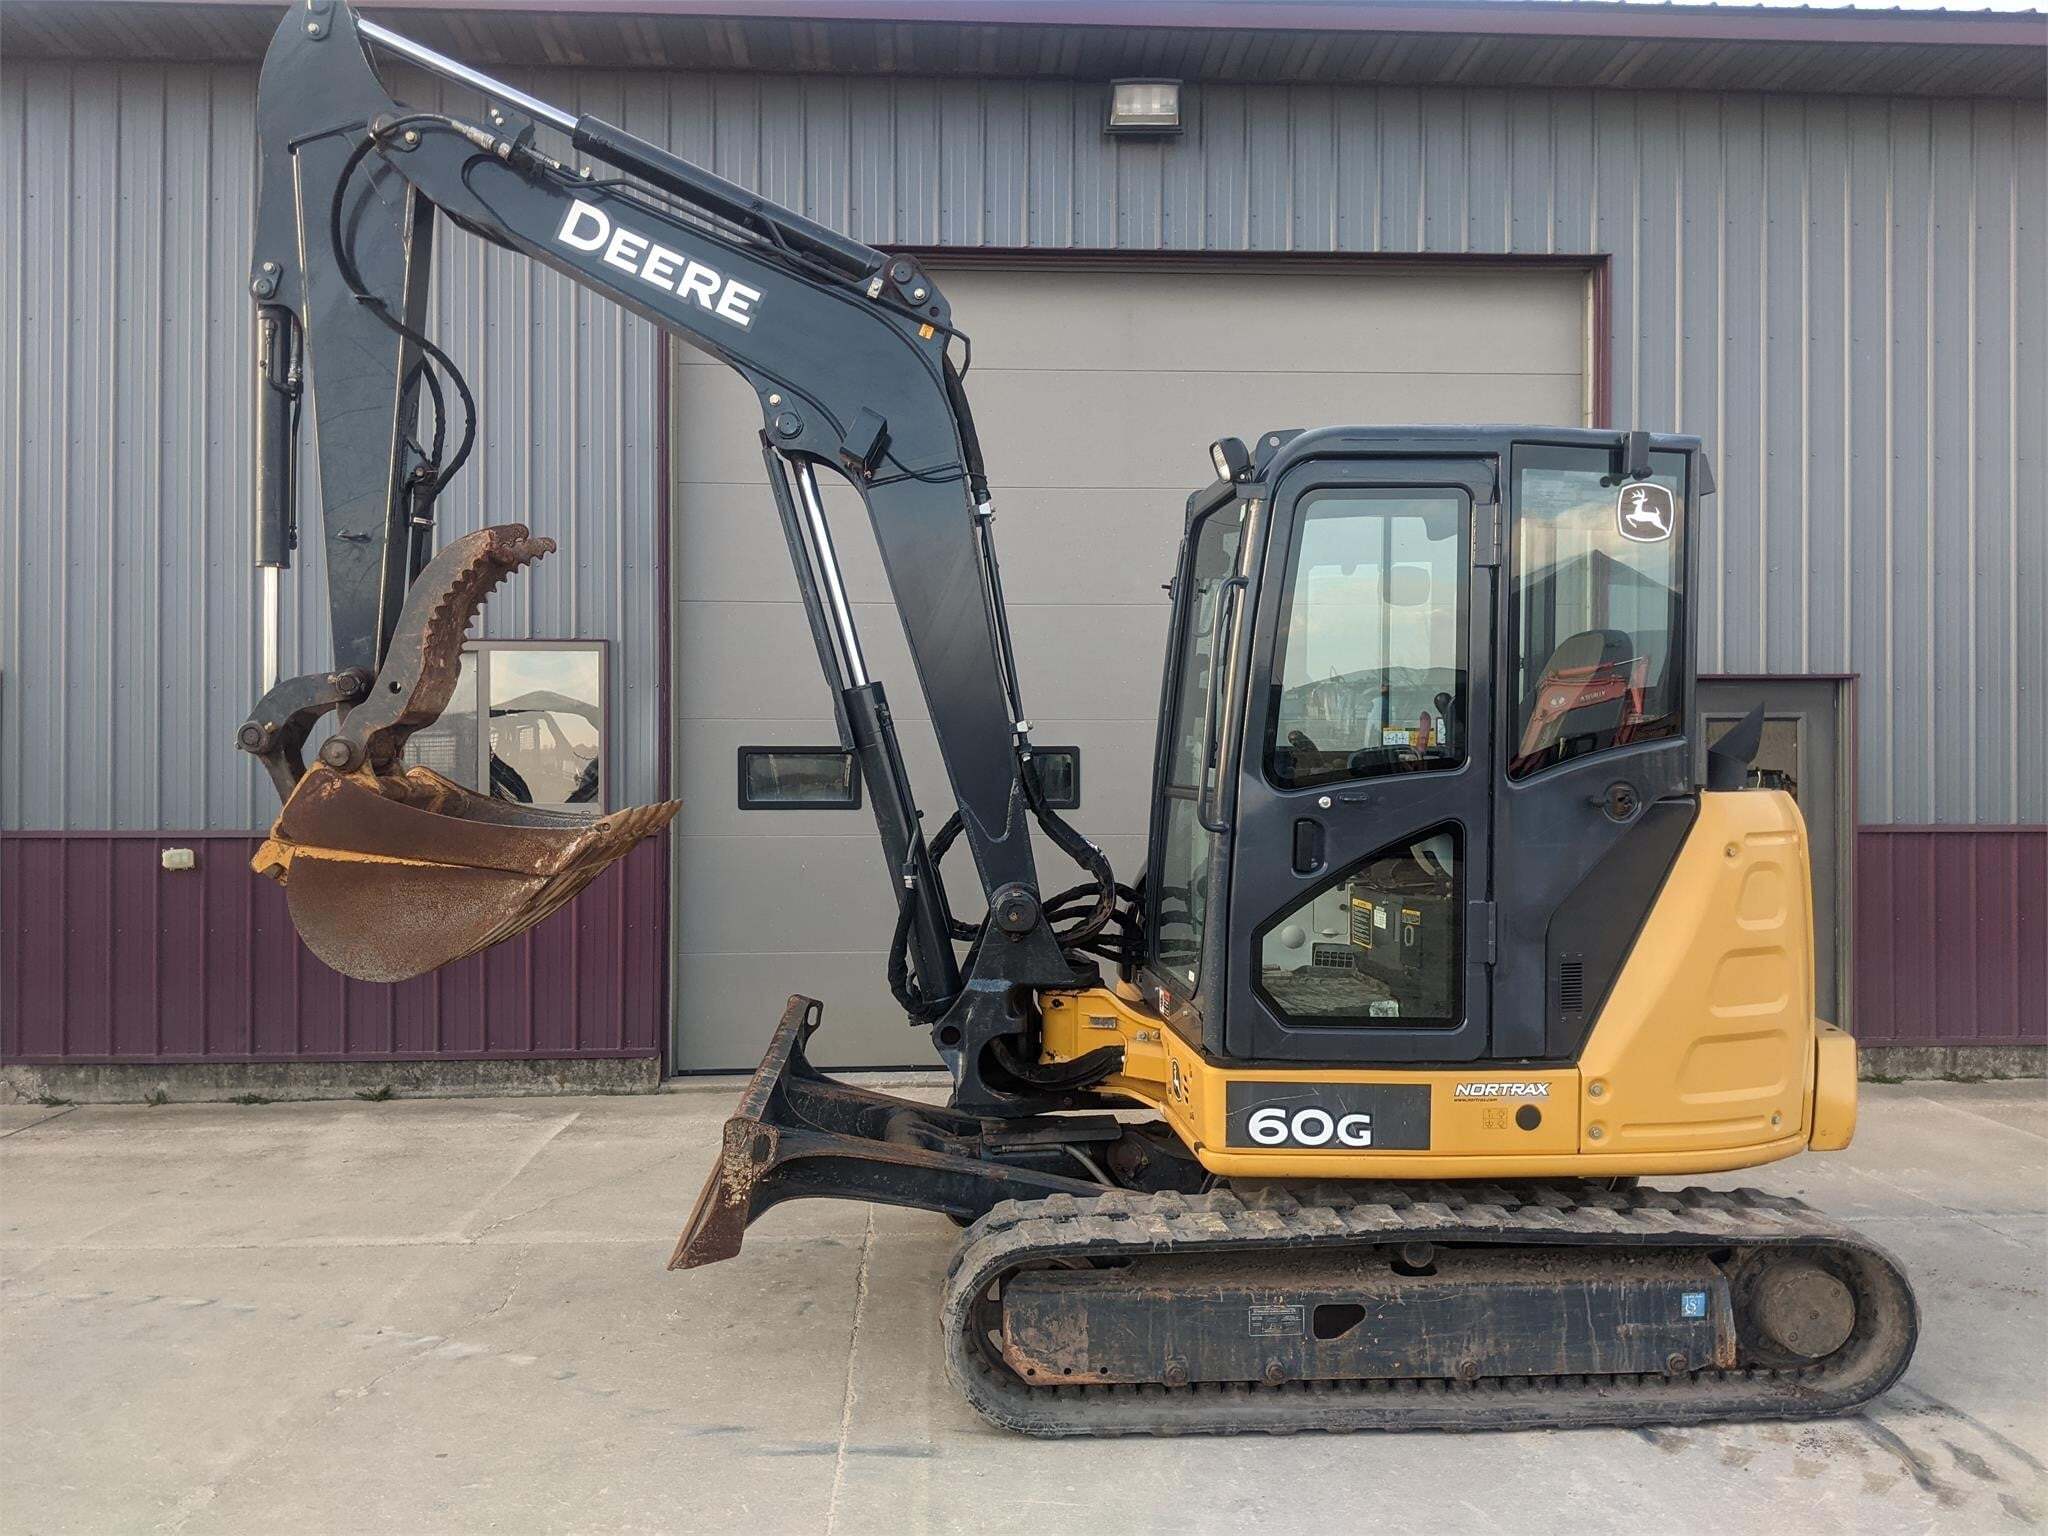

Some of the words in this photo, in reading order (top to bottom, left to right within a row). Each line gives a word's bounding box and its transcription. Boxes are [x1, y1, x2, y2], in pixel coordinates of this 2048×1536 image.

[558, 199, 761, 327] DEERE
[1454, 1083, 1551, 1097] NORTRAX
[1248, 1107, 1372, 1147] 60G
